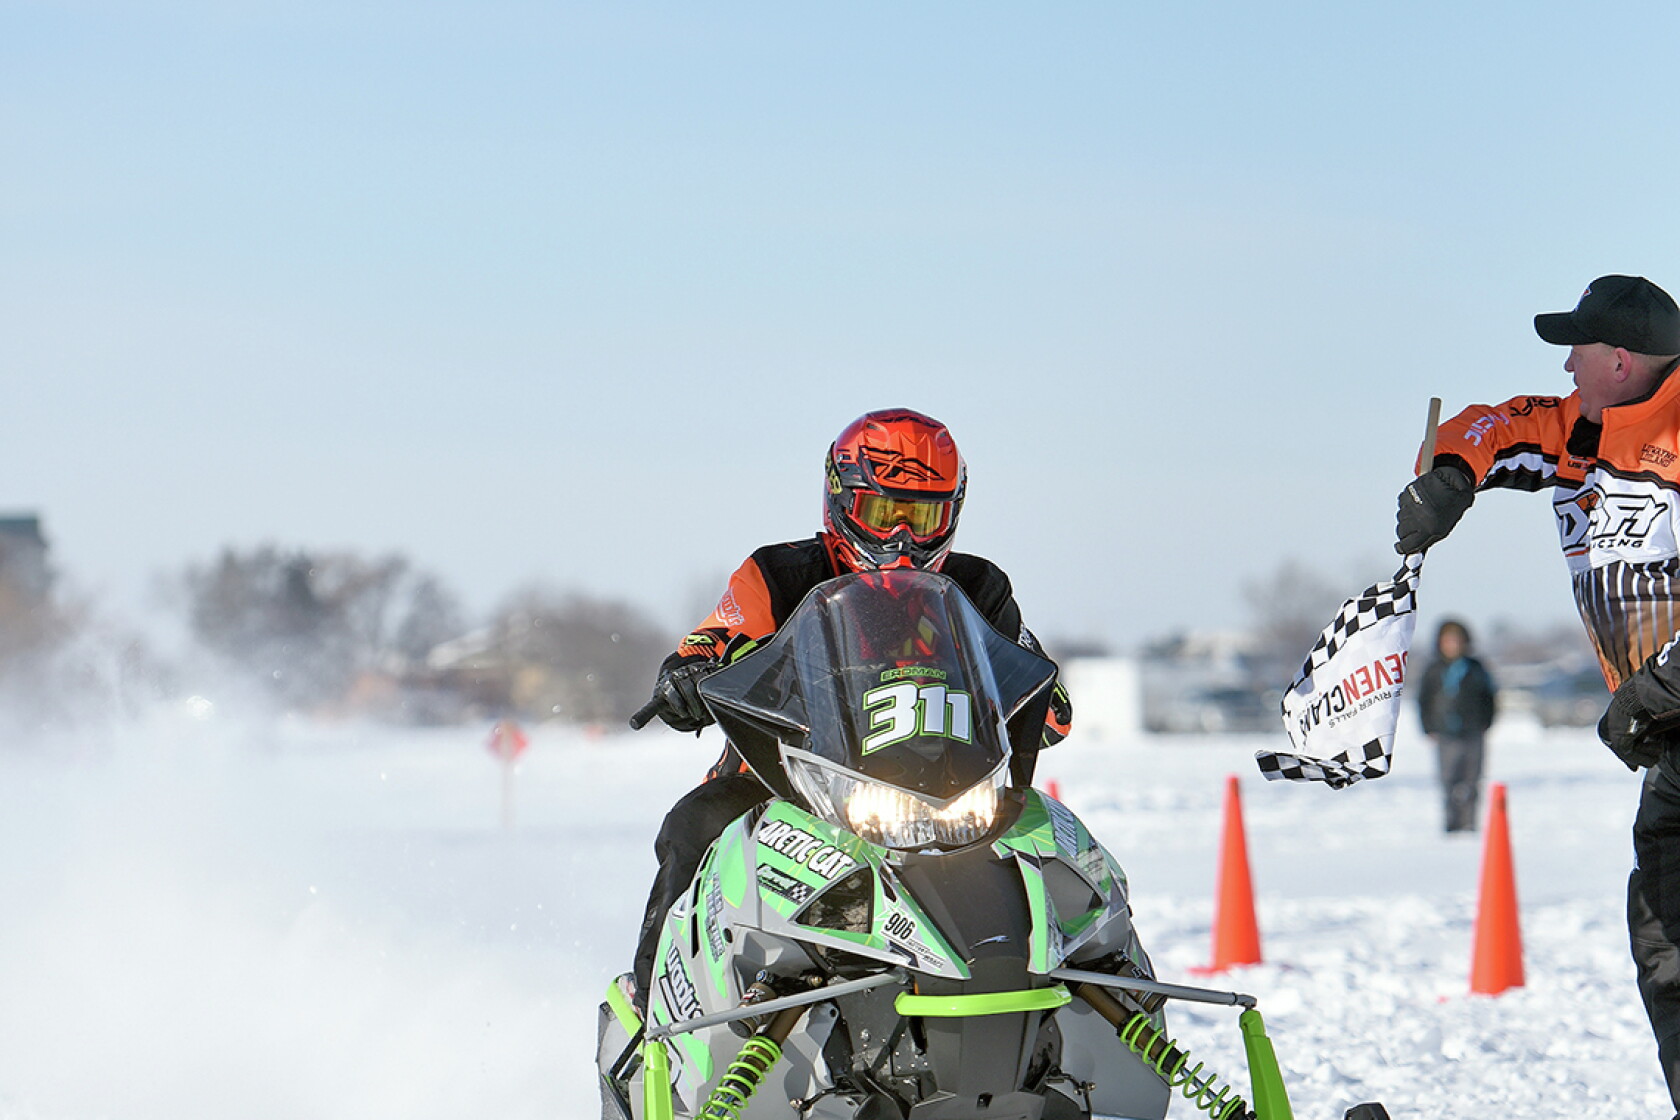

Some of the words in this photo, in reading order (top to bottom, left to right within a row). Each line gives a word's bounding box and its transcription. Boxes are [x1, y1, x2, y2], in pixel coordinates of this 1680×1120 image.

[1591, 538, 1643, 549] CING
[881, 666, 947, 682] ERDMAN
[1360, 690, 1391, 711] RIVER
[863, 682, 972, 756] 311
[1328, 708, 1358, 728] FALLS
[758, 819, 825, 864] ARCTIC
[808, 846, 857, 880] CAT
[884, 912, 916, 940] 906
